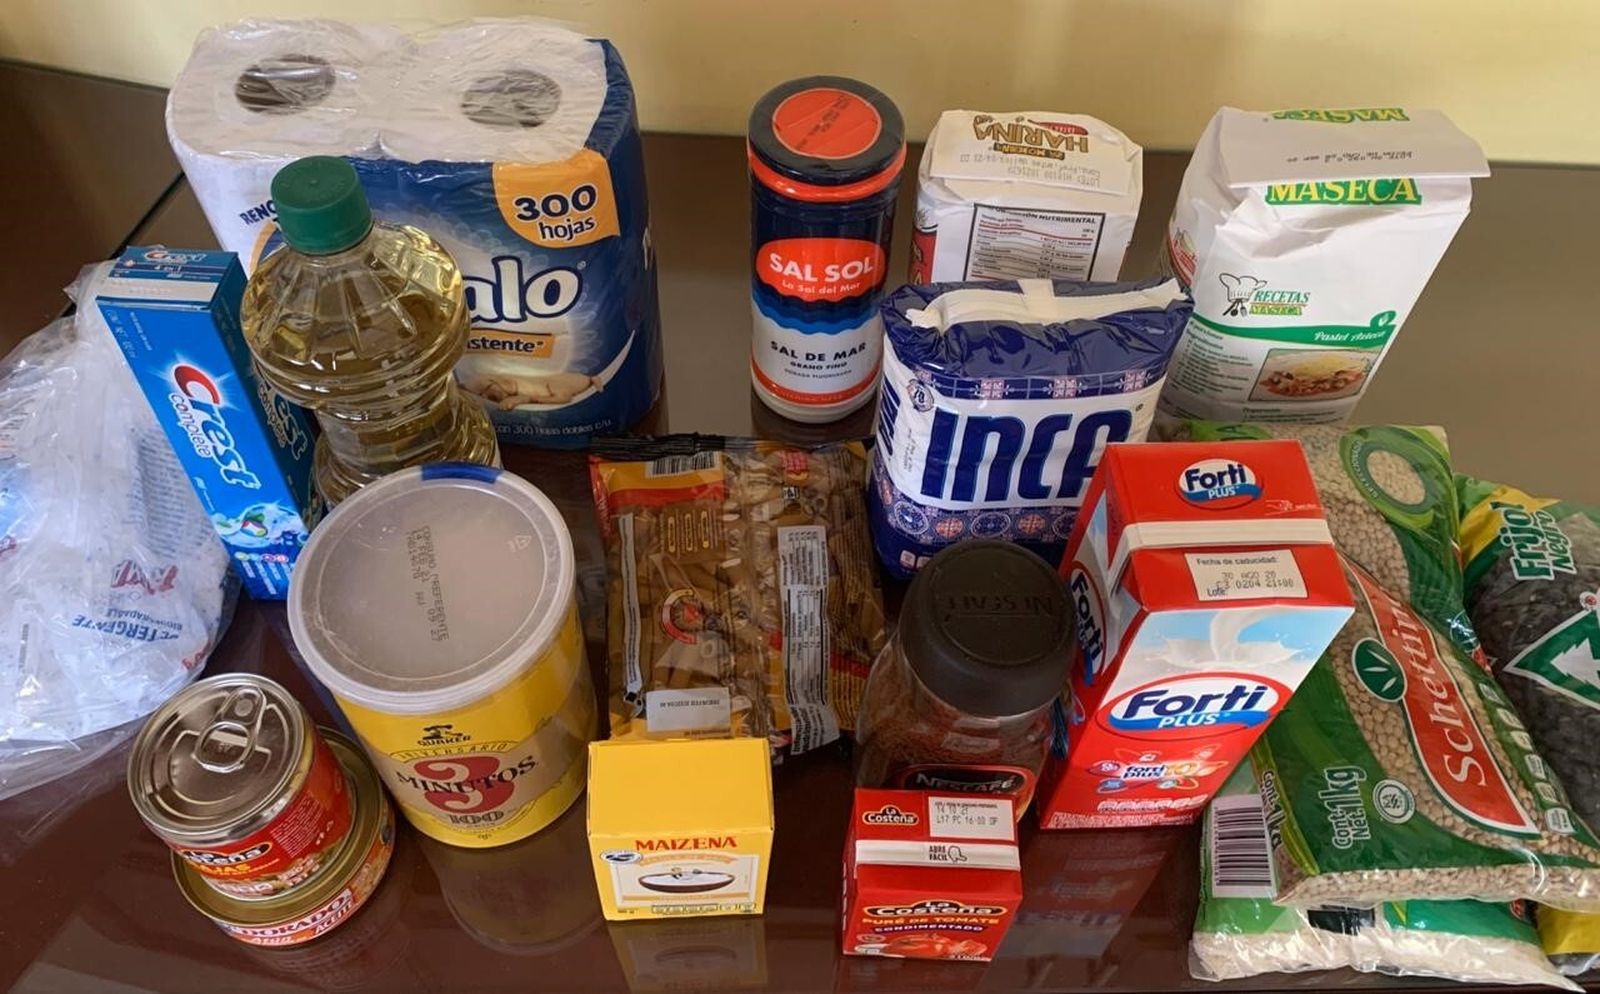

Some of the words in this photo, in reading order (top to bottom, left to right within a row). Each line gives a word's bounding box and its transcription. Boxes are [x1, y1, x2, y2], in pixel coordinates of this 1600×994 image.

[973, 115, 1089, 153] HARINA
[514, 184, 597, 221] 300
[1267, 177, 1420, 203] MASECA
[538, 216, 595, 240] hojas
[769, 252, 818, 282] SAL
[824, 257, 874, 283] SOL
[462, 255, 584, 322] alo
[797, 282, 816, 293] Sal
[818, 284, 837, 294] del
[1252, 290, 1311, 304] RECETAS
[467, 336, 538, 353] stente
[770, 340, 799, 360] SAL
[805, 352, 827, 362] DE
[833, 342, 867, 361] MAR
[789, 361, 823, 371] GRANO
[168, 393, 212, 458] complete
[172, 363, 261, 489] Crest
[1184, 463, 1247, 491] Forti
[1207, 487, 1236, 499] PLUS
[1490, 500, 1555, 580] Frijol
[1534, 508, 1577, 575] Negro
[1196, 557, 1221, 567] Fecha
[1222, 557, 1233, 566] de
[72, 614, 180, 642] ETERGENTE
[1072, 572, 1104, 660] Forti
[1122, 684, 1269, 720] Forti
[1158, 711, 1221, 729] PLUS
[417, 735, 472, 747] QUAKER
[395, 755, 537, 794] MINUTOS
[413, 756, 515, 814] 3
[635, 836, 738, 852] MAIZENA
[874, 923, 984, 933] CONDIMENTADO
[934, 916, 1000, 925] TOMATE
